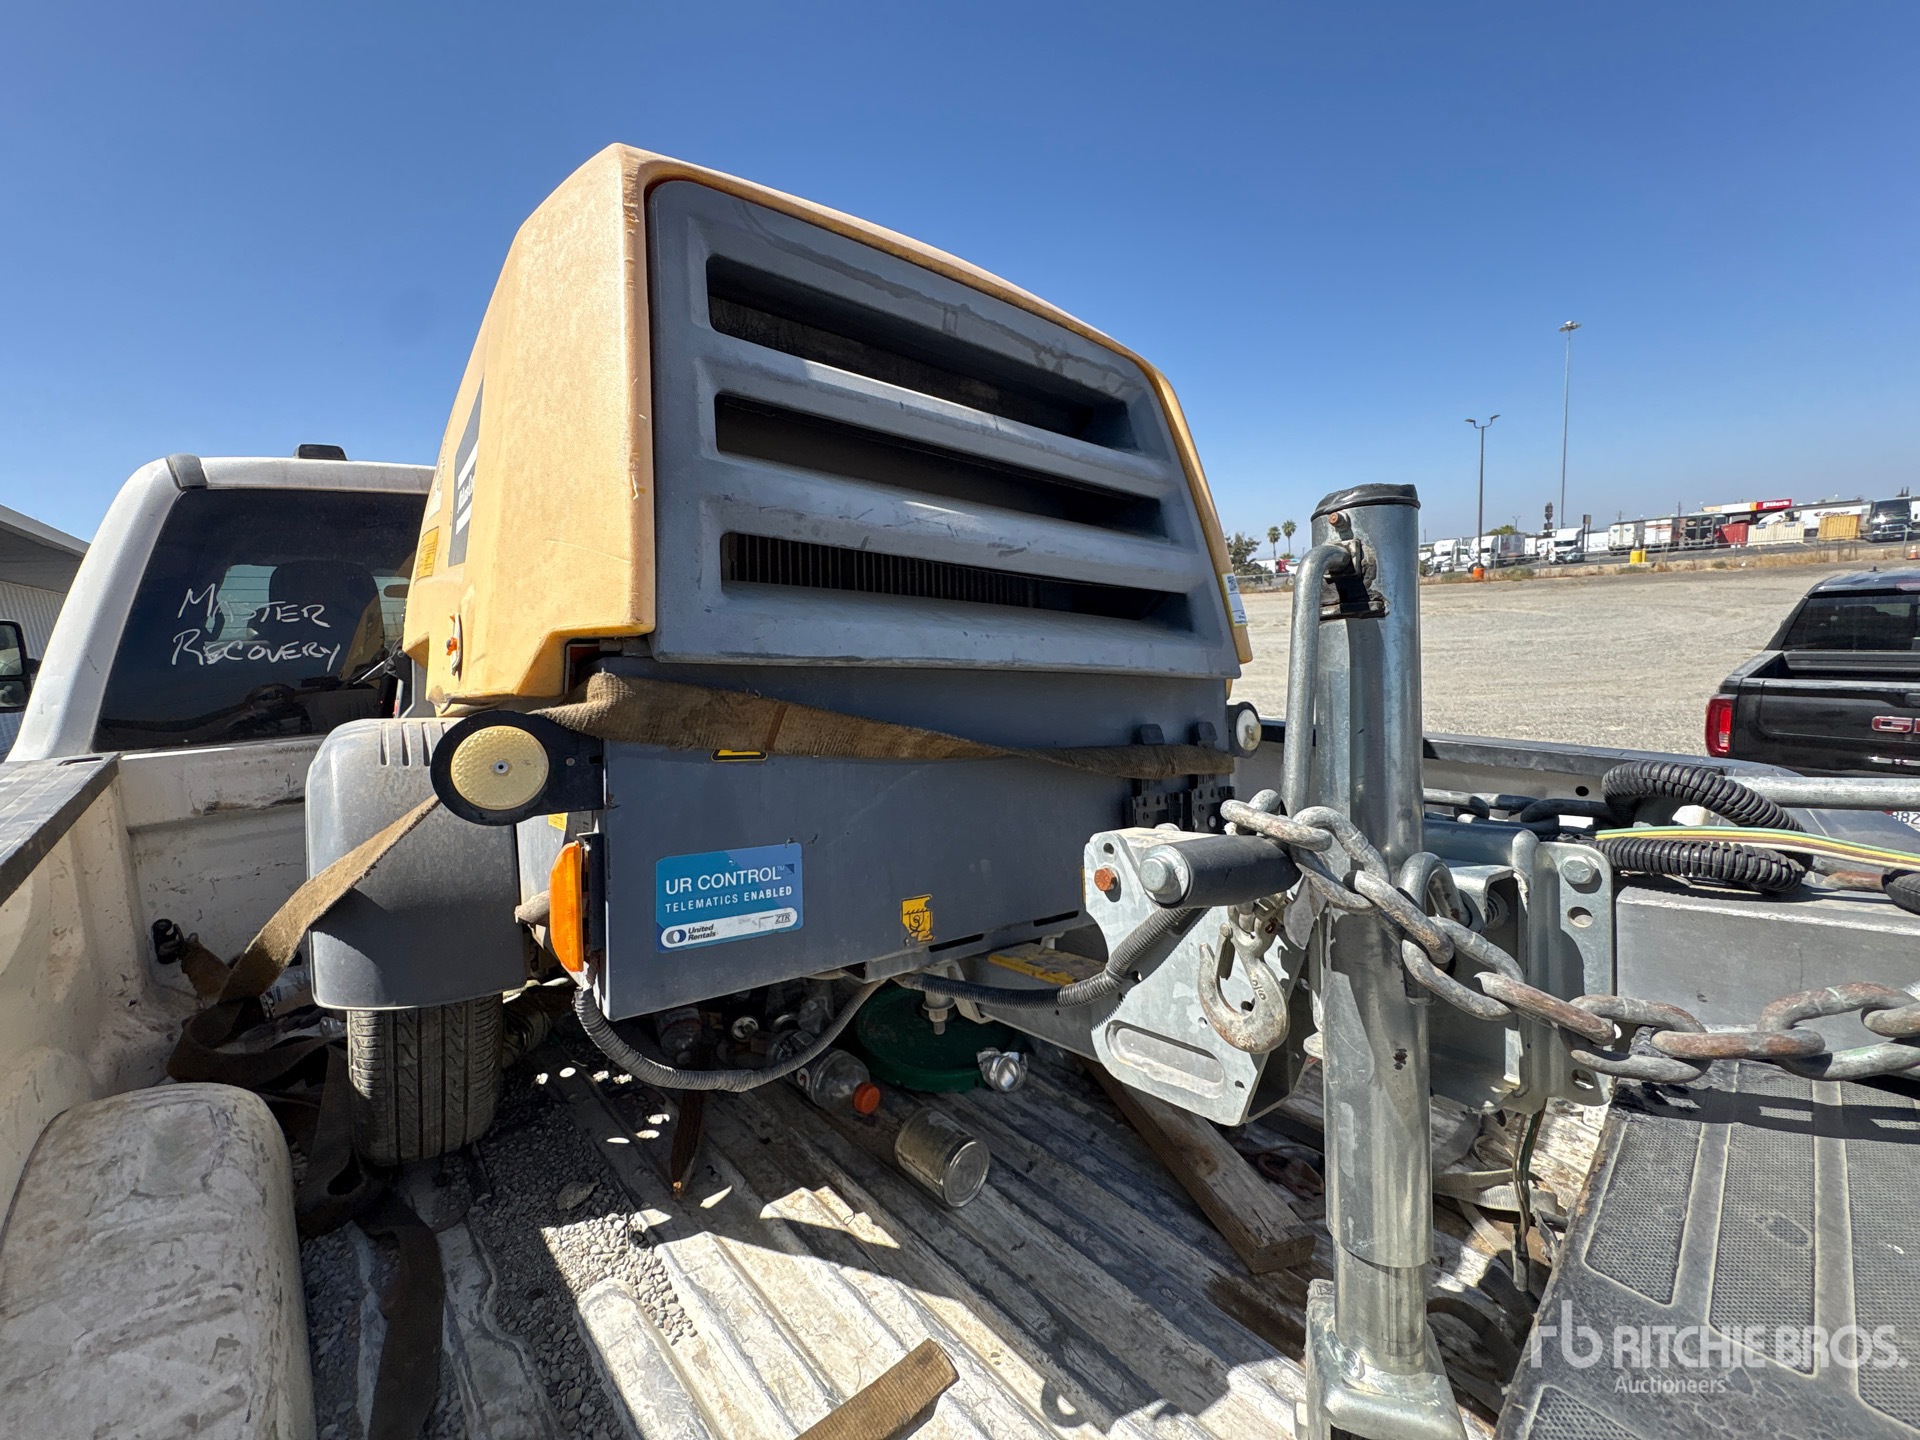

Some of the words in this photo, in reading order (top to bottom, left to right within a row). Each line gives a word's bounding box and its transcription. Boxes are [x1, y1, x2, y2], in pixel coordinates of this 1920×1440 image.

[171, 628, 341, 672] RECOVERY
[665, 877, 692, 895] UR
[665, 894, 739, 913] TELEMATICS
[743, 885, 793, 902] ENABLED
[688, 924, 714, 936] United
[688, 931, 716, 942] Rentals
